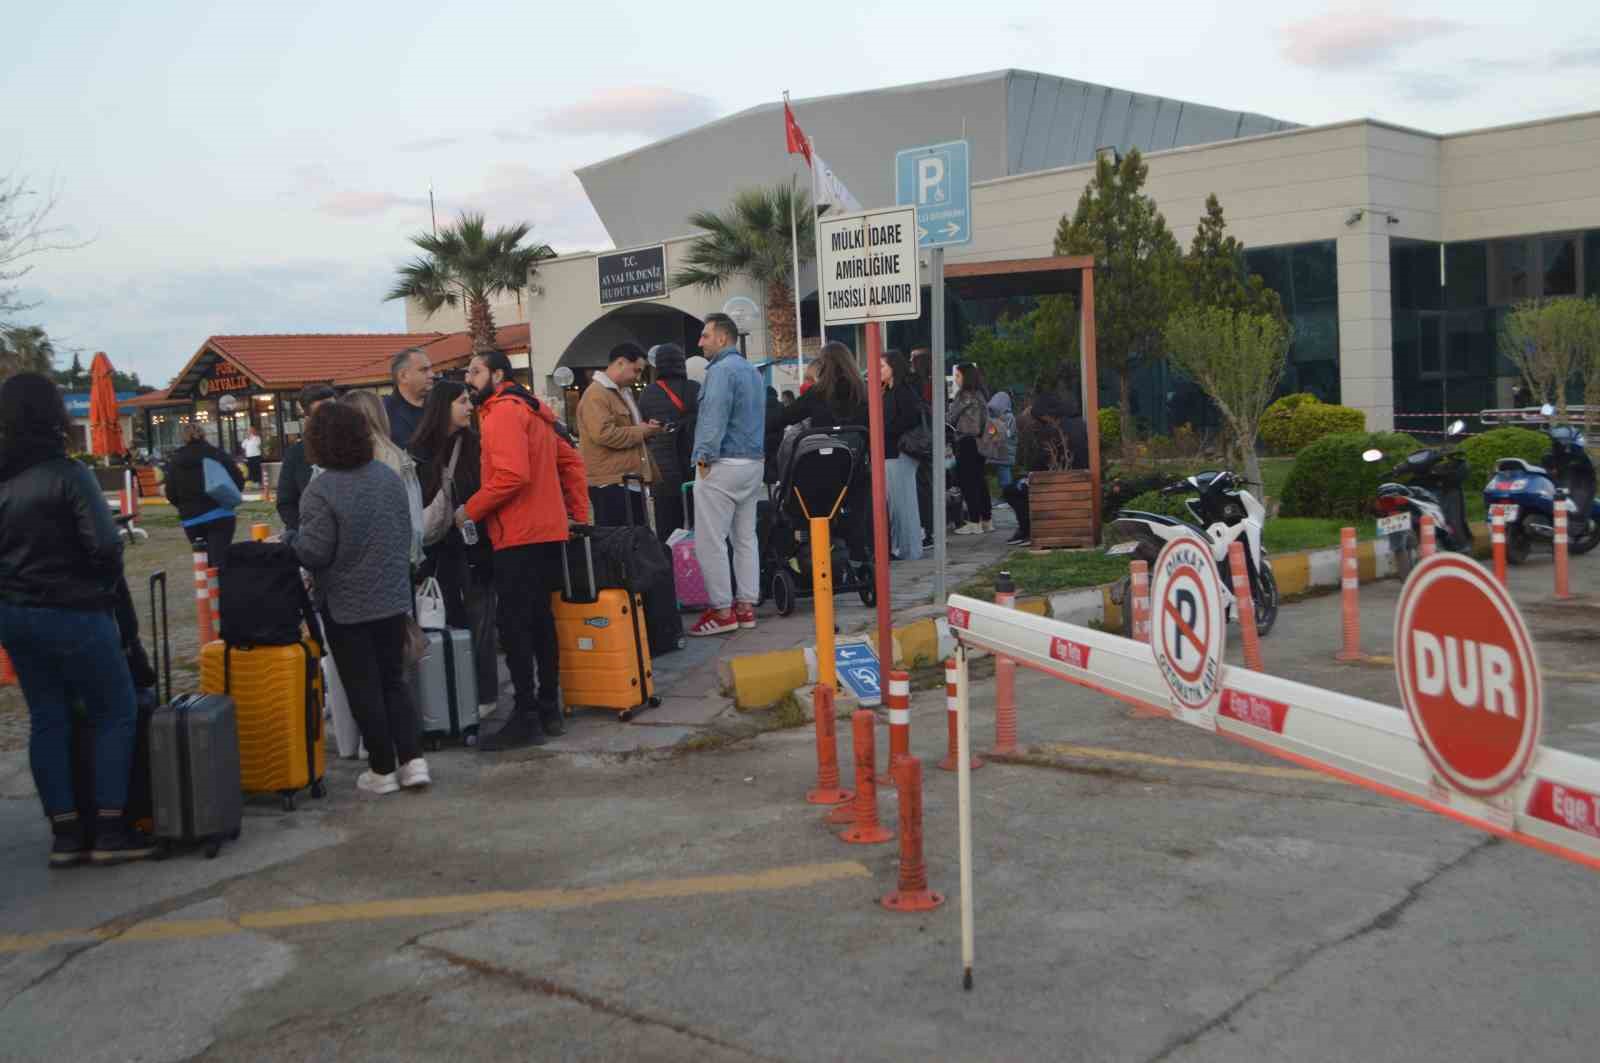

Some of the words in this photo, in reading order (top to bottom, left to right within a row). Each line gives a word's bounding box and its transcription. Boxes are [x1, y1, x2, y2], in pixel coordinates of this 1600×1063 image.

[919, 158, 944, 204] P
[831, 225, 865, 251] MÜLKİ
[868, 223, 902, 246] İDARE
[835, 252, 900, 280] AMİRLİĞİNE
[827, 284, 866, 310] TAHSİSLİ
[869, 283, 911, 306] ALANDIR
[1175, 588, 1197, 660] P
[1412, 629, 1519, 719] DUR
